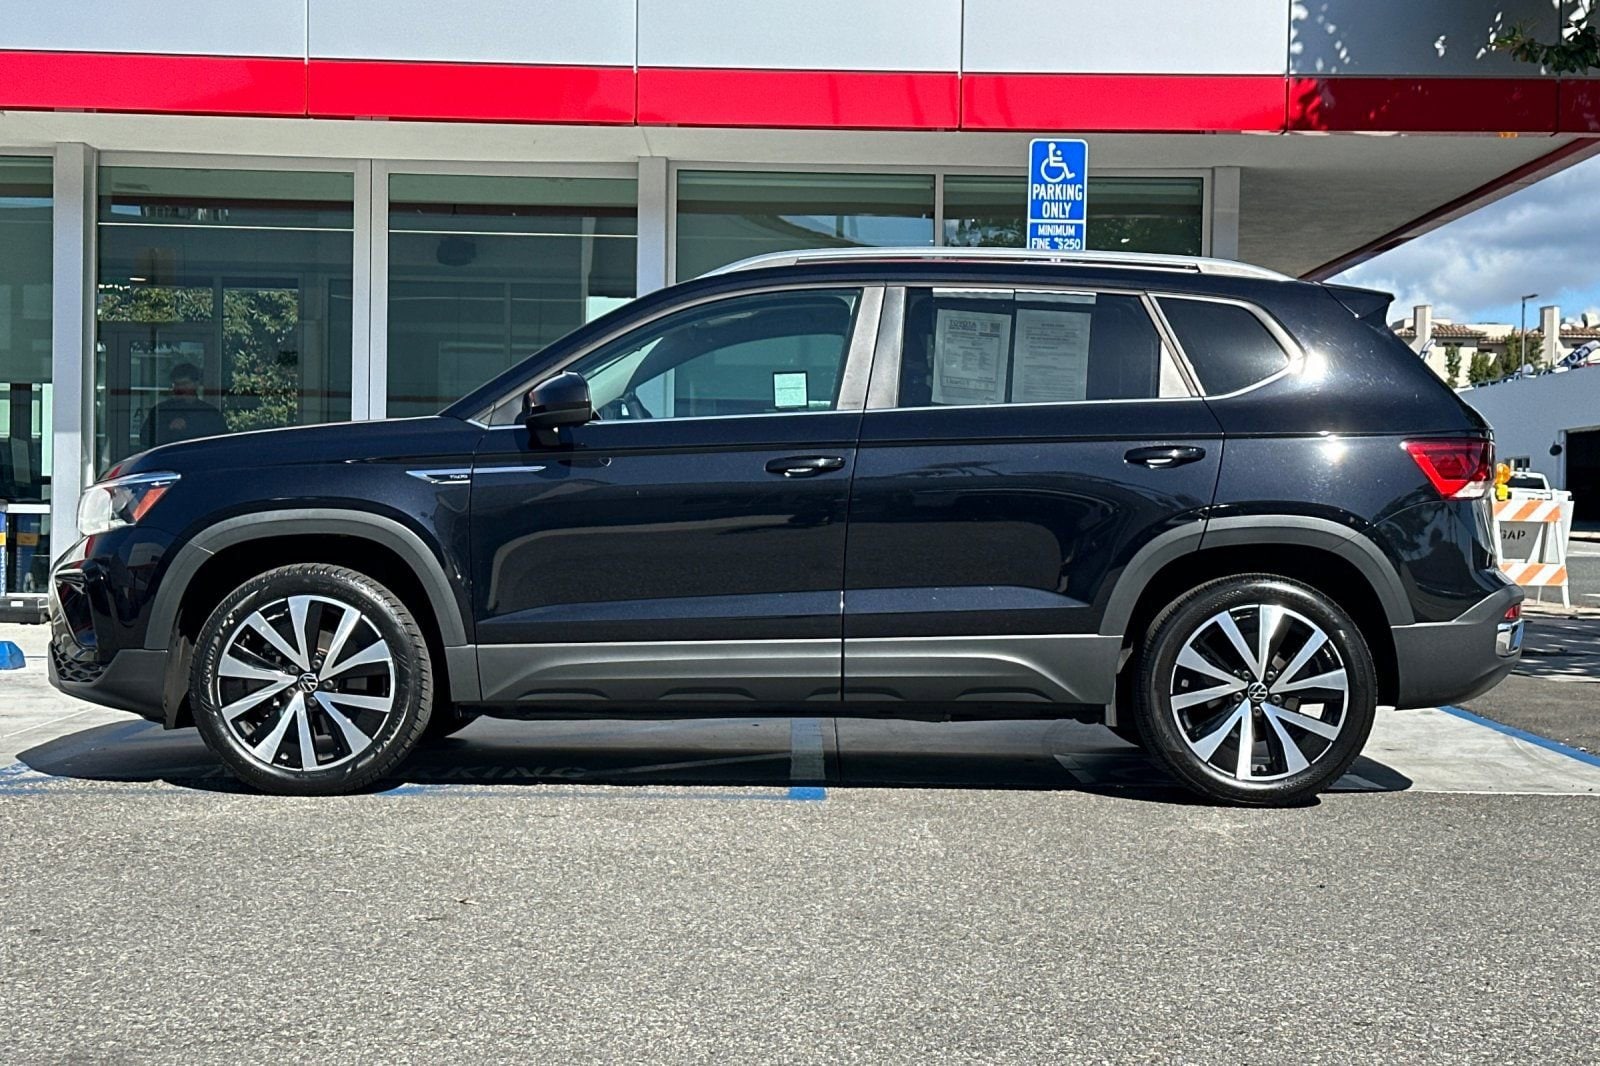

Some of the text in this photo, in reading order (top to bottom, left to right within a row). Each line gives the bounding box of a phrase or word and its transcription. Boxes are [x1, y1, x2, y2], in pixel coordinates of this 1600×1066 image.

[1032, 183, 1083, 201] PARKING
[1042, 201, 1072, 219] ONLY
[1038, 224, 1075, 236] MINIMUM
[1031, 237, 1051, 249] FINE
